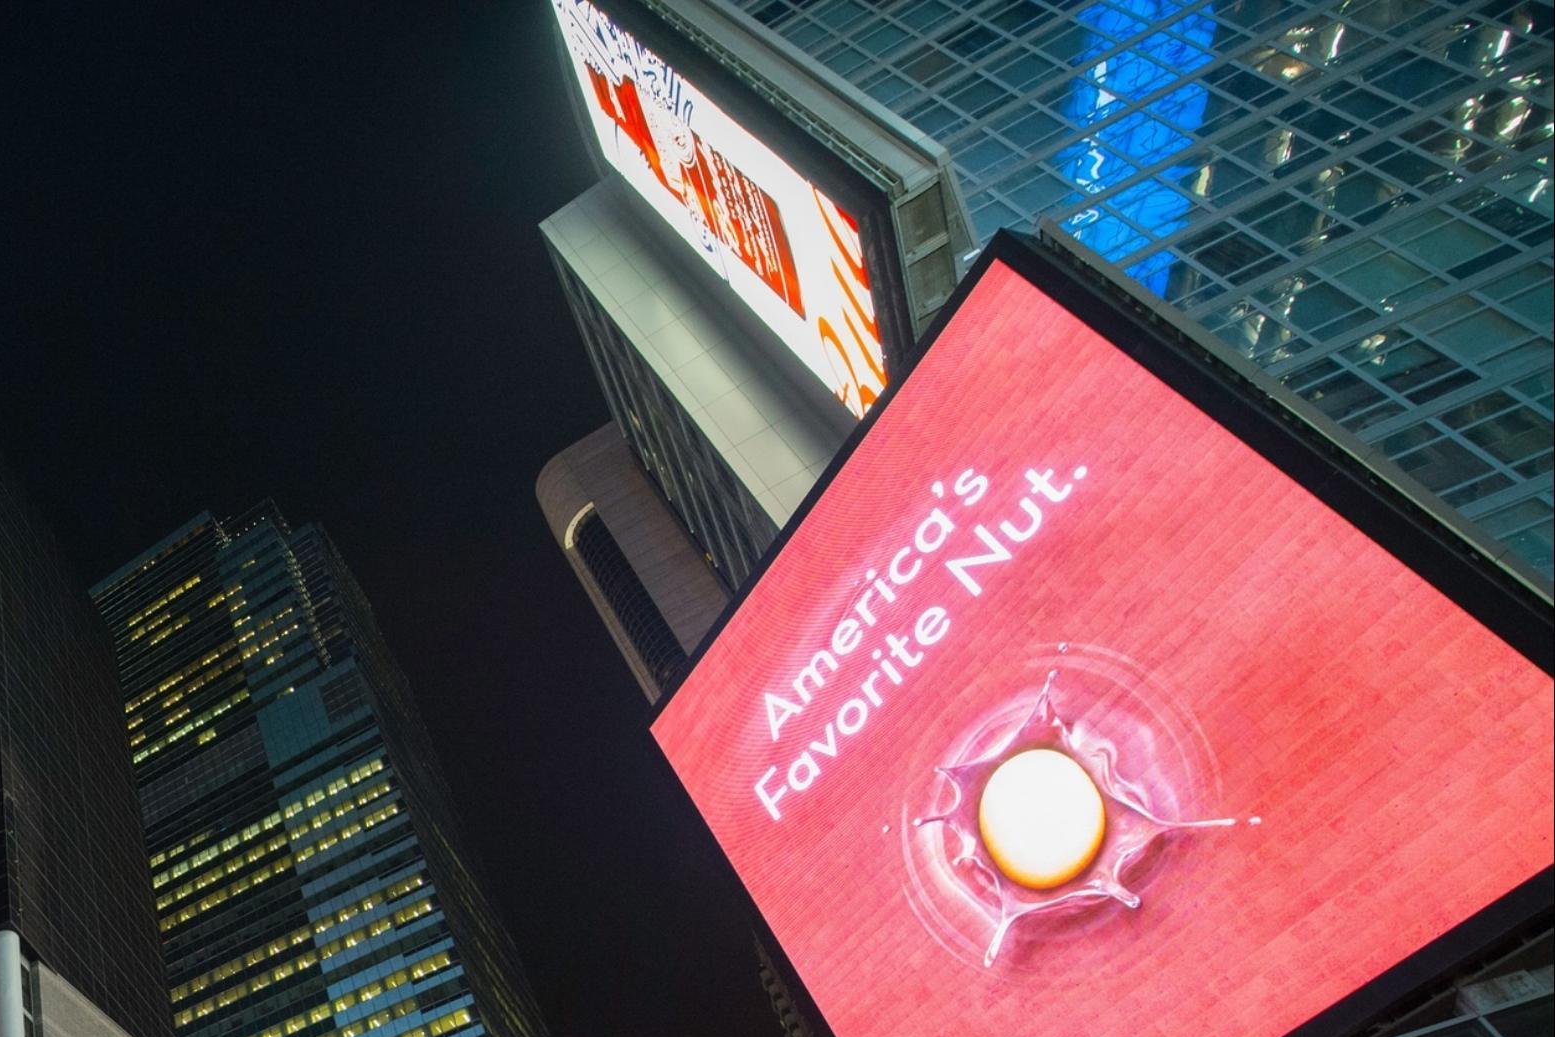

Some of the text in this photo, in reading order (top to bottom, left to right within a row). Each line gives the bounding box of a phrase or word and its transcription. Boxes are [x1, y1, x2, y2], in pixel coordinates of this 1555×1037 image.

[754, 465, 1087, 821] Favorite Nut.
[761, 468, 988, 741] America's
